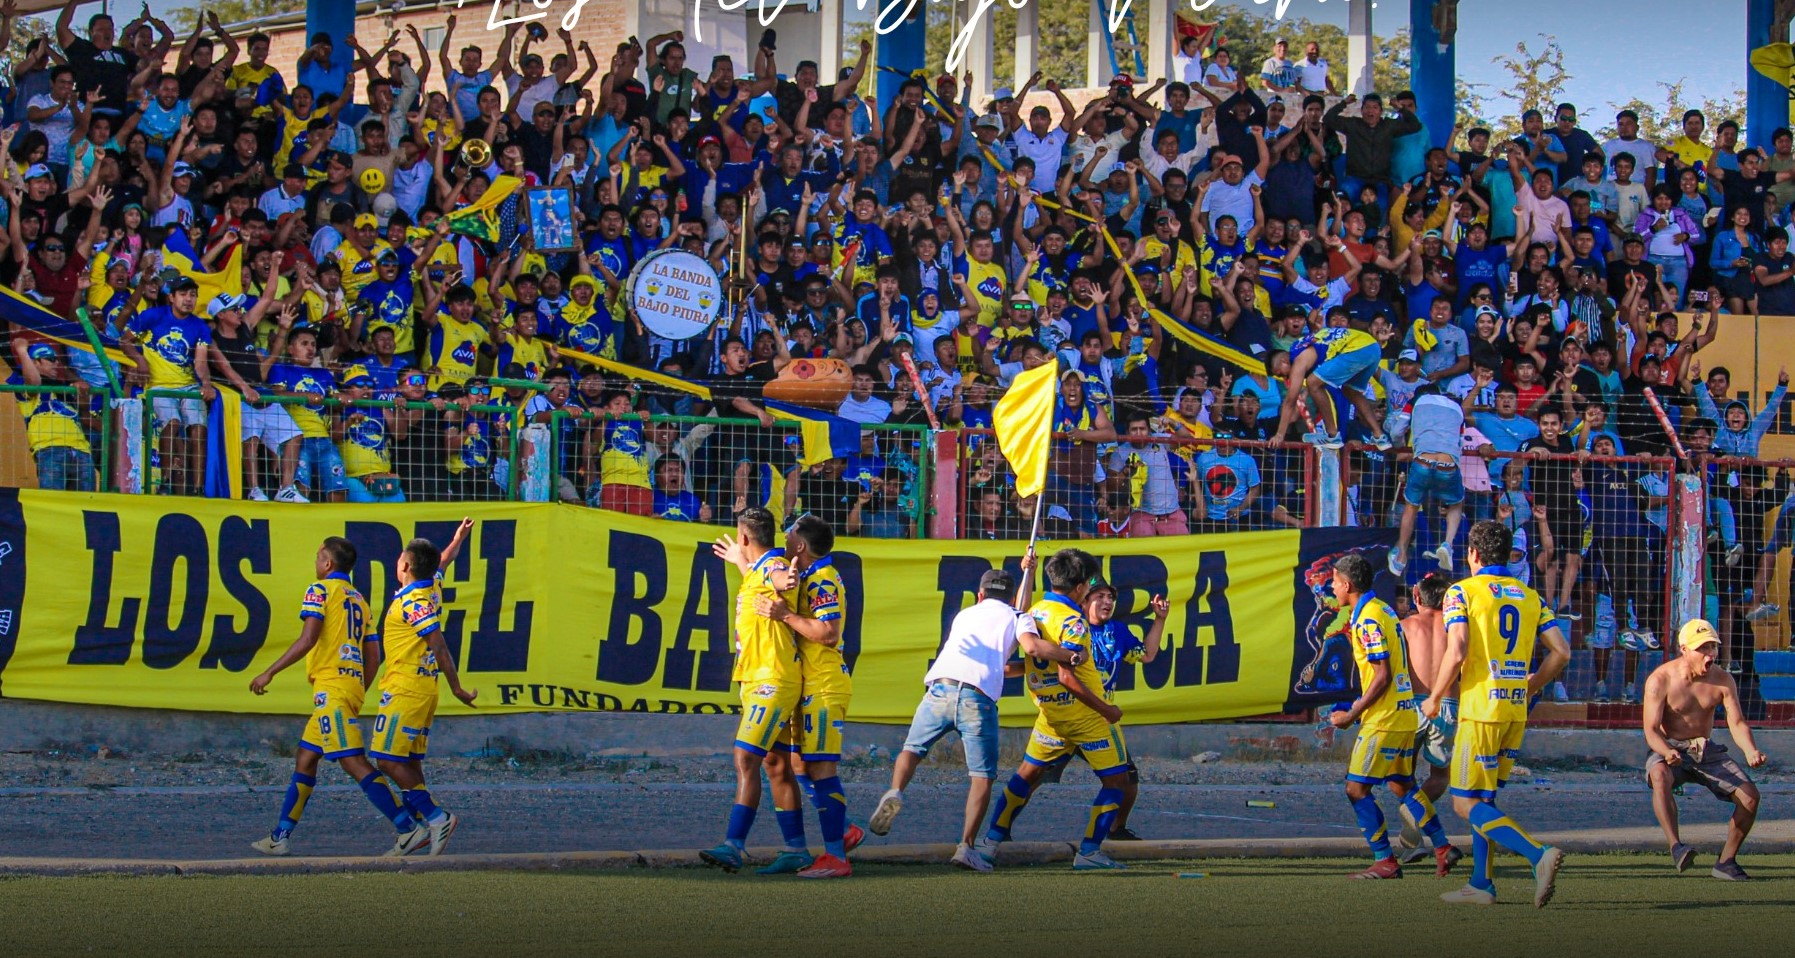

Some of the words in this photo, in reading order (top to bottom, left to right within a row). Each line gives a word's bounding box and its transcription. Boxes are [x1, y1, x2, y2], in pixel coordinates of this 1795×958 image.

[652, 263, 669, 277] LA
[671, 267, 712, 288] BANDA
[665, 284, 691, 302] DEL
[636, 296, 670, 315] BAJO
[671, 305, 711, 325] PIURA
[453, 348, 475, 361] AVA
[67, 510, 272, 672] LOS
[343, 597, 364, 644] 18
[1498, 604, 1520, 655] 9
[318, 715, 332, 735] 18
[749, 704, 767, 725] 11
